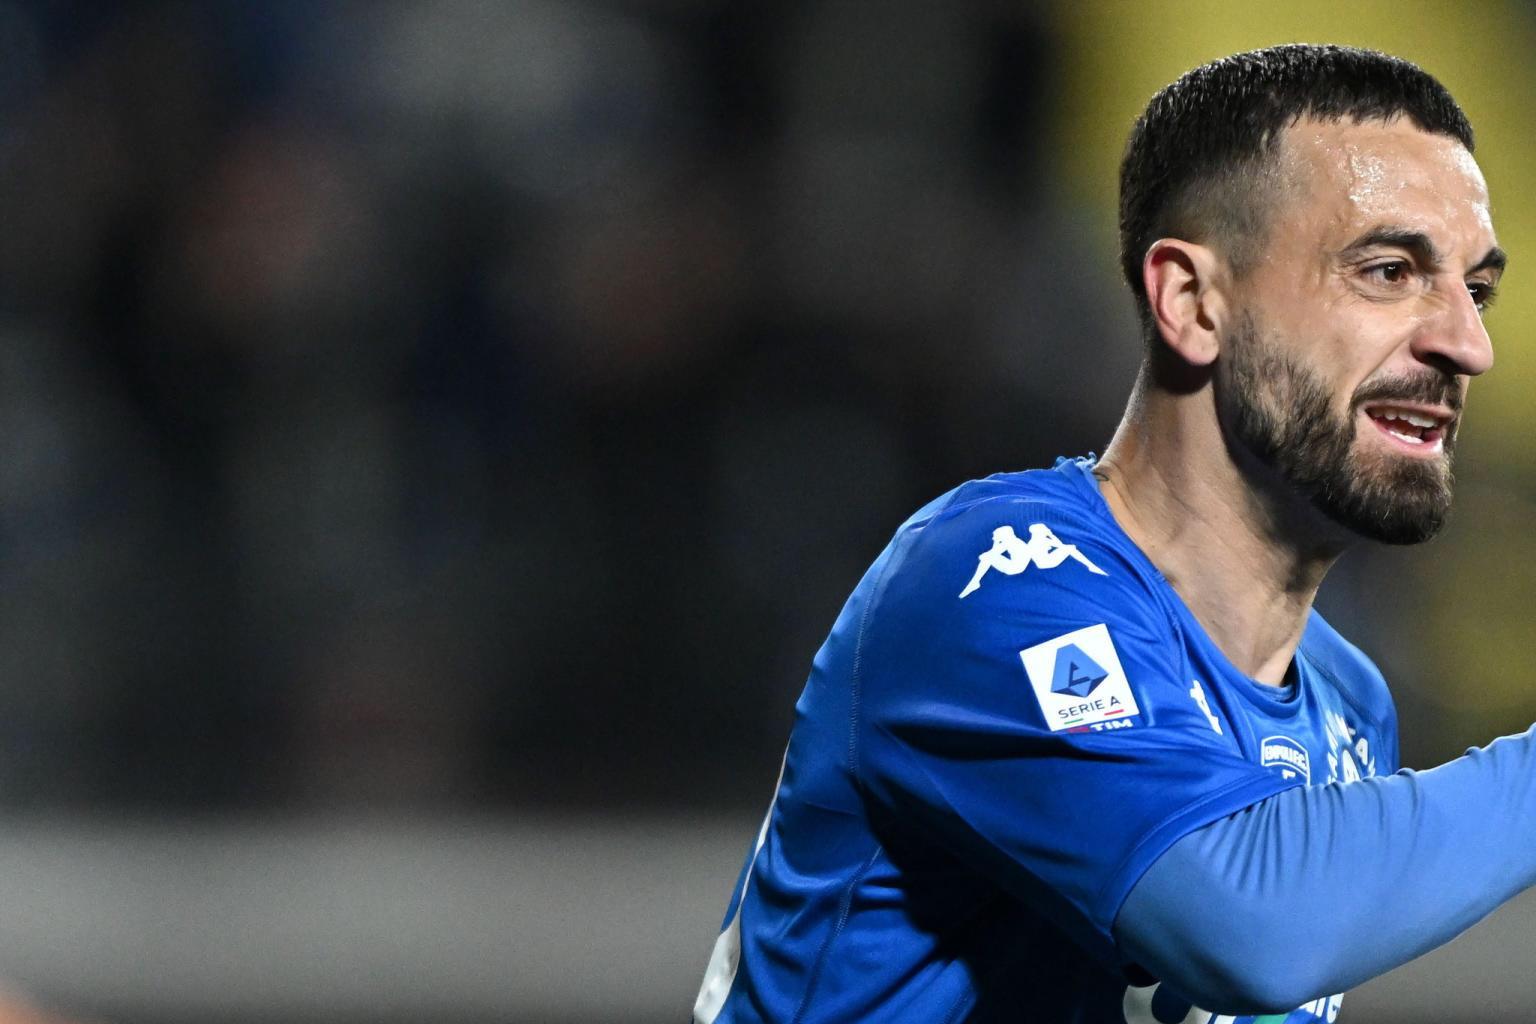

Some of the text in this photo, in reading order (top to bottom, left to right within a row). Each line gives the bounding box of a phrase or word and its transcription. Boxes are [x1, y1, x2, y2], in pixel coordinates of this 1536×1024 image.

[1058, 695, 1121, 719] SERIE A
[1090, 718, 1133, 731] TIM
